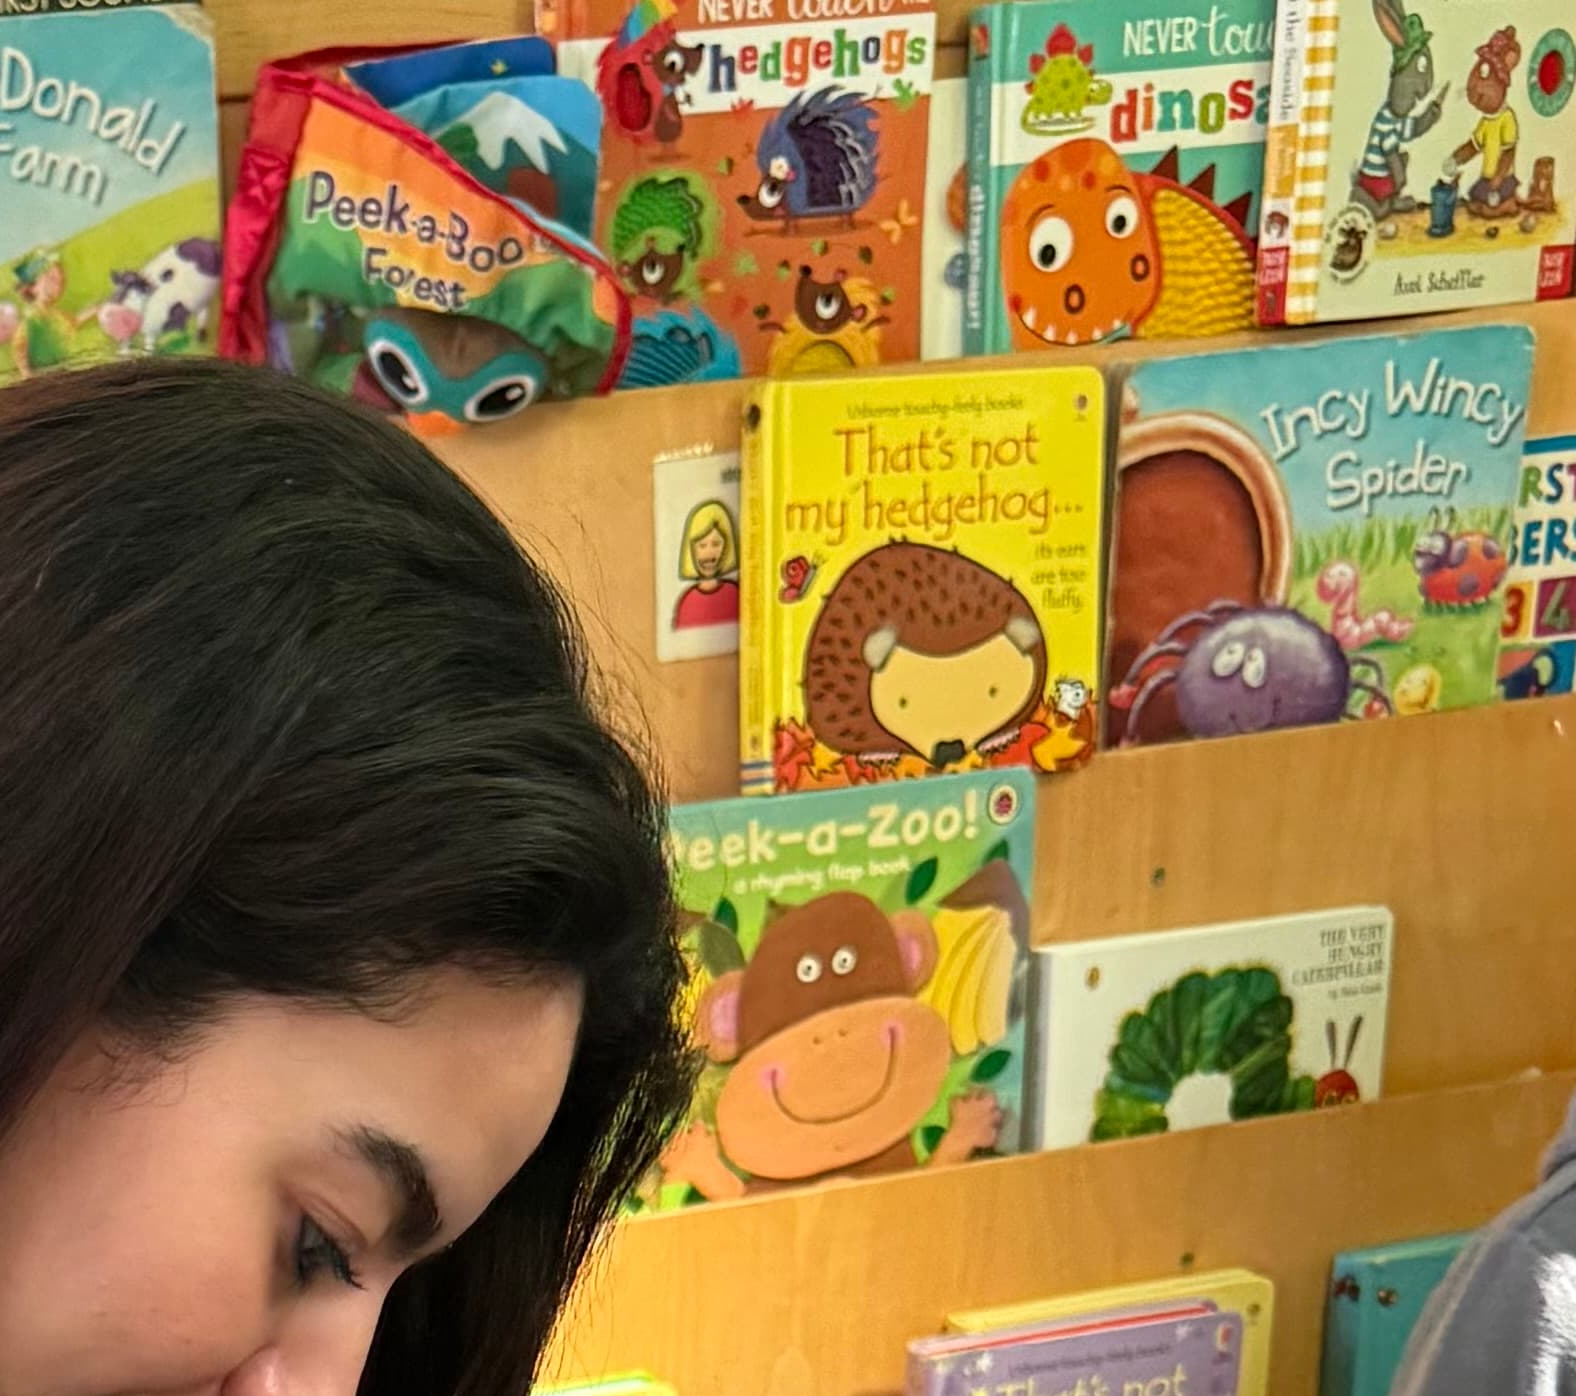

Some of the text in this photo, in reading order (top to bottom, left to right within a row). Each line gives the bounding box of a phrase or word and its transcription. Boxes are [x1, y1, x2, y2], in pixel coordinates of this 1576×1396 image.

[698, 0, 773, 23] NEVER
[1123, 16, 1199, 57] NEVER
[707, 29, 927, 92] hedgehogs
[1110, 79, 1271, 144] dinosa
[306, 171, 523, 271] Peek-a-Boo
[1260, 358, 1524, 463] Incy Wincy
[834, 422, 1040, 477] That's not
[1327, 440, 1468, 517] Spider
[786, 474, 1084, 547] my hedgehog...
[1518, 463, 1576, 508] RST
[1541, 580, 1571, 632] 4
